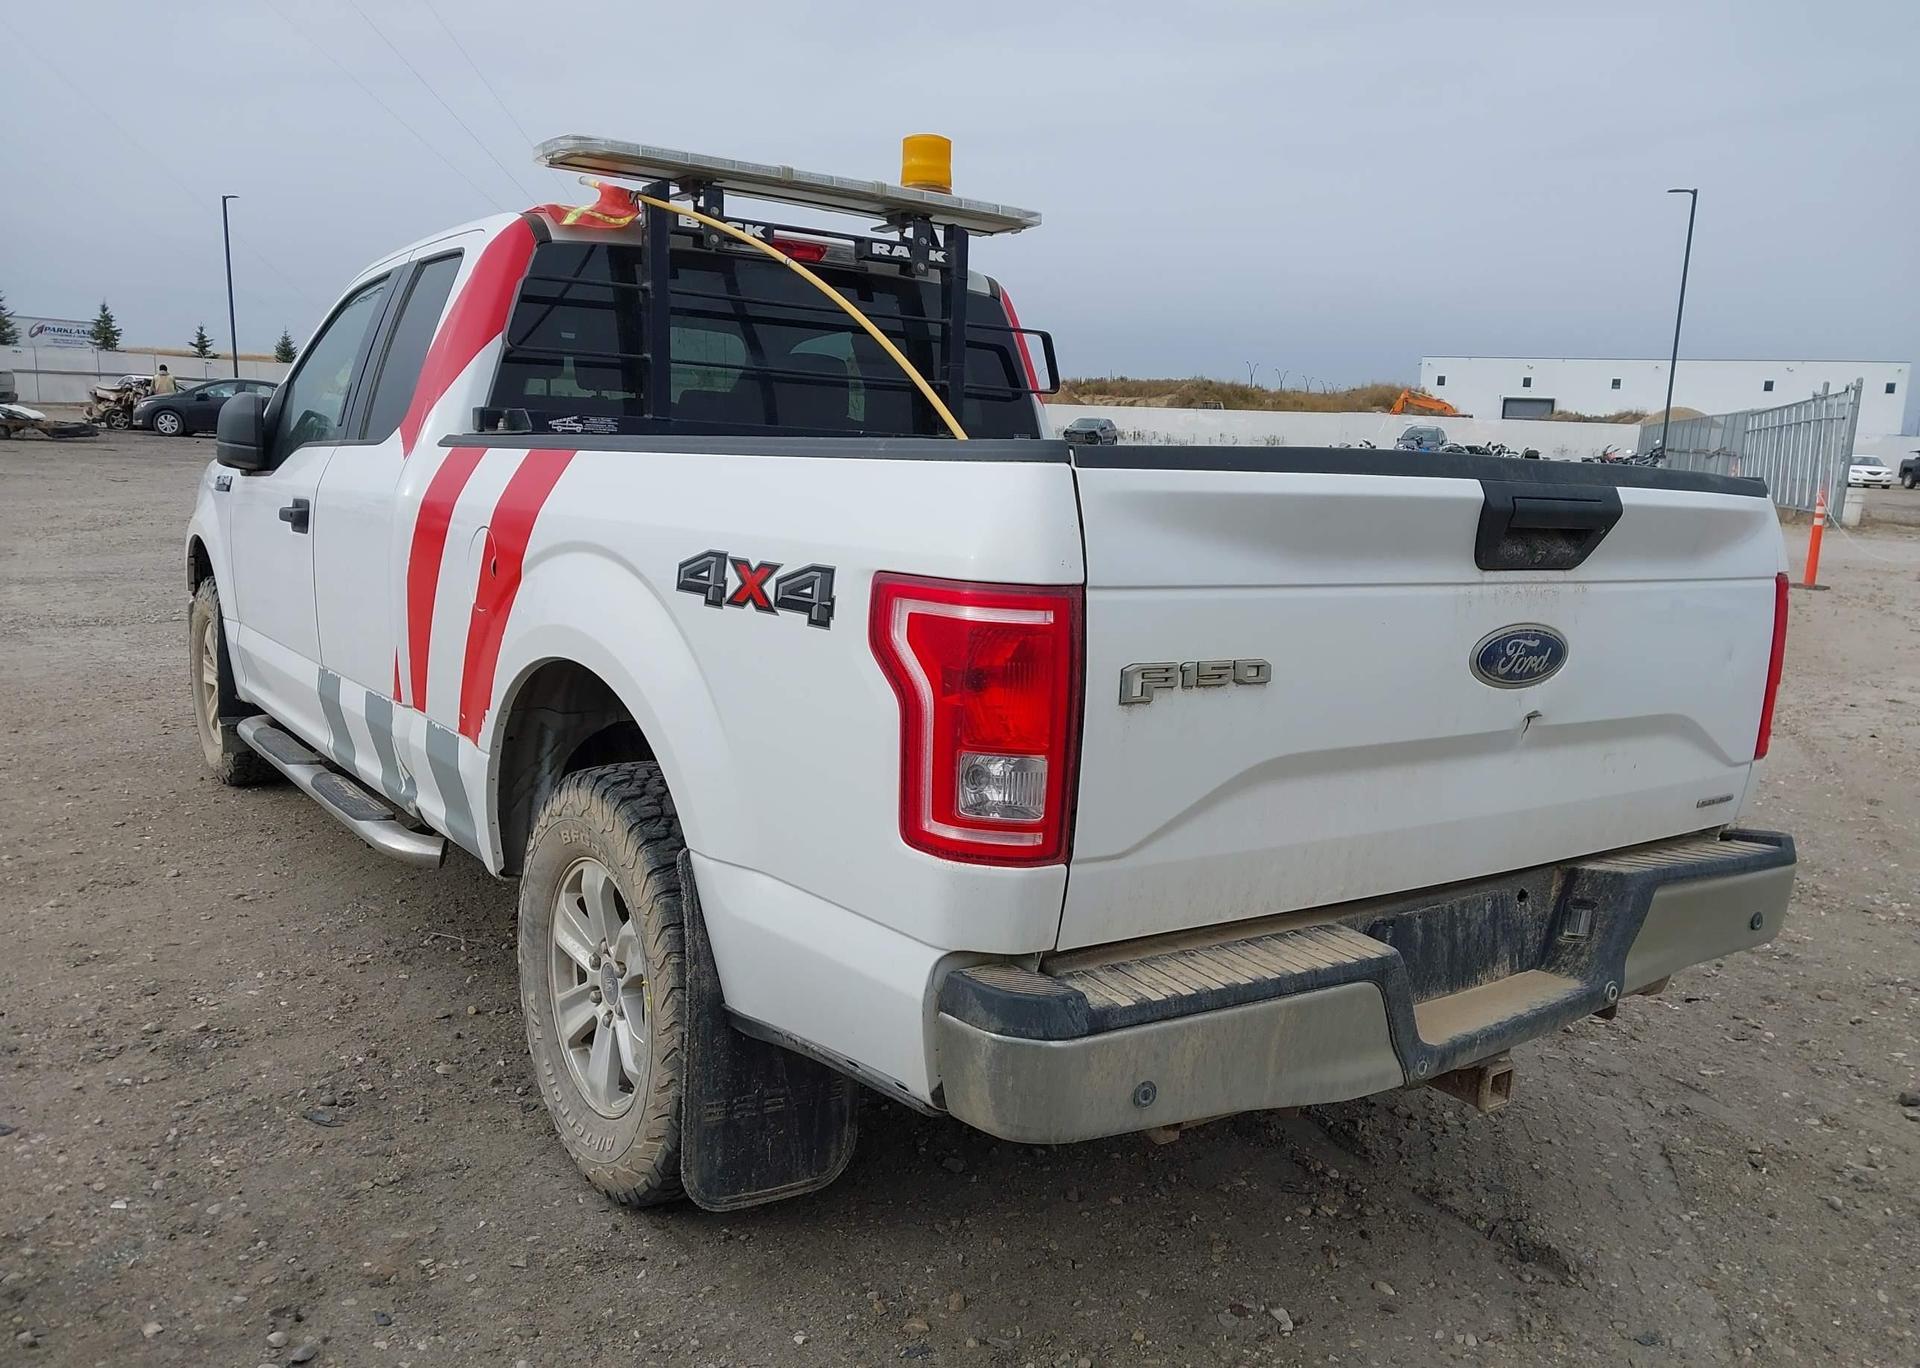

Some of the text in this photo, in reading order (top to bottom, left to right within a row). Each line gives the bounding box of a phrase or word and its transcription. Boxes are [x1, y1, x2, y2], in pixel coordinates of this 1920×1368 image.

[678, 213, 947, 263] BCK RAK
[44, 325, 91, 336] PARKLAN
[1497, 638, 1552, 675] Ford
